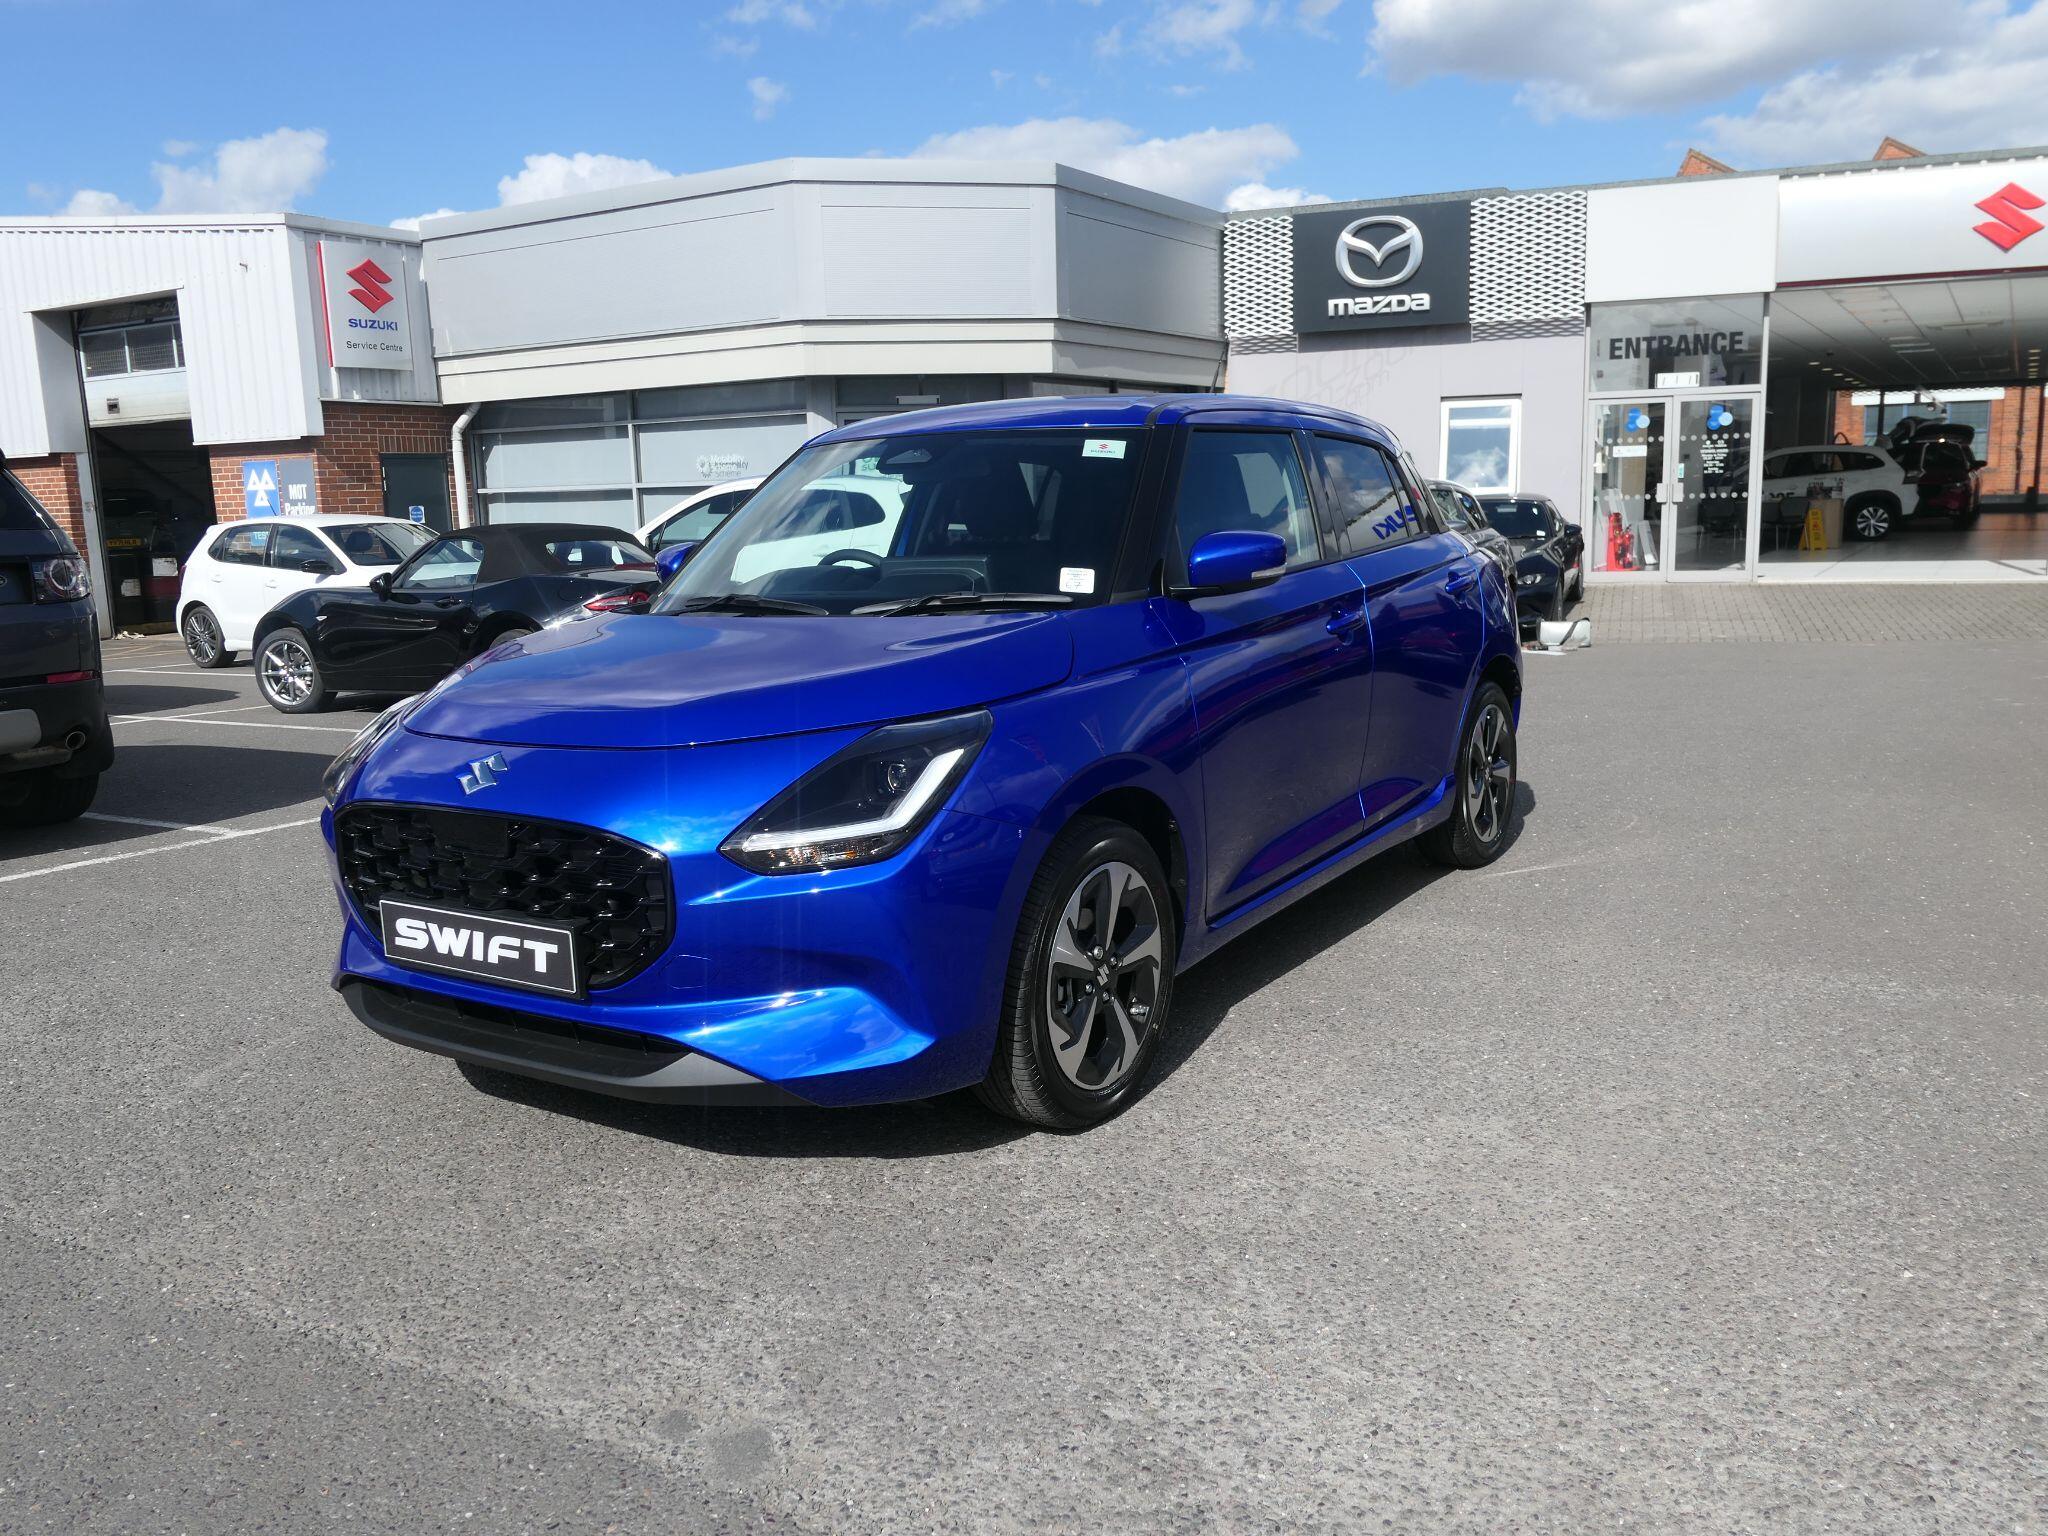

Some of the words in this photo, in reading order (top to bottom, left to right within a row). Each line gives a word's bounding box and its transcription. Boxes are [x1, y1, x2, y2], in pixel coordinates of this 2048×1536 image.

[348, 318, 398, 331] SUZUKI
[346, 340, 378, 350] Service
[380, 342, 403, 352] Centre
[1609, 331, 1744, 360] ENTRANCE
[288, 484, 307, 500] MOT
[395, 917, 558, 973] SWIFT
